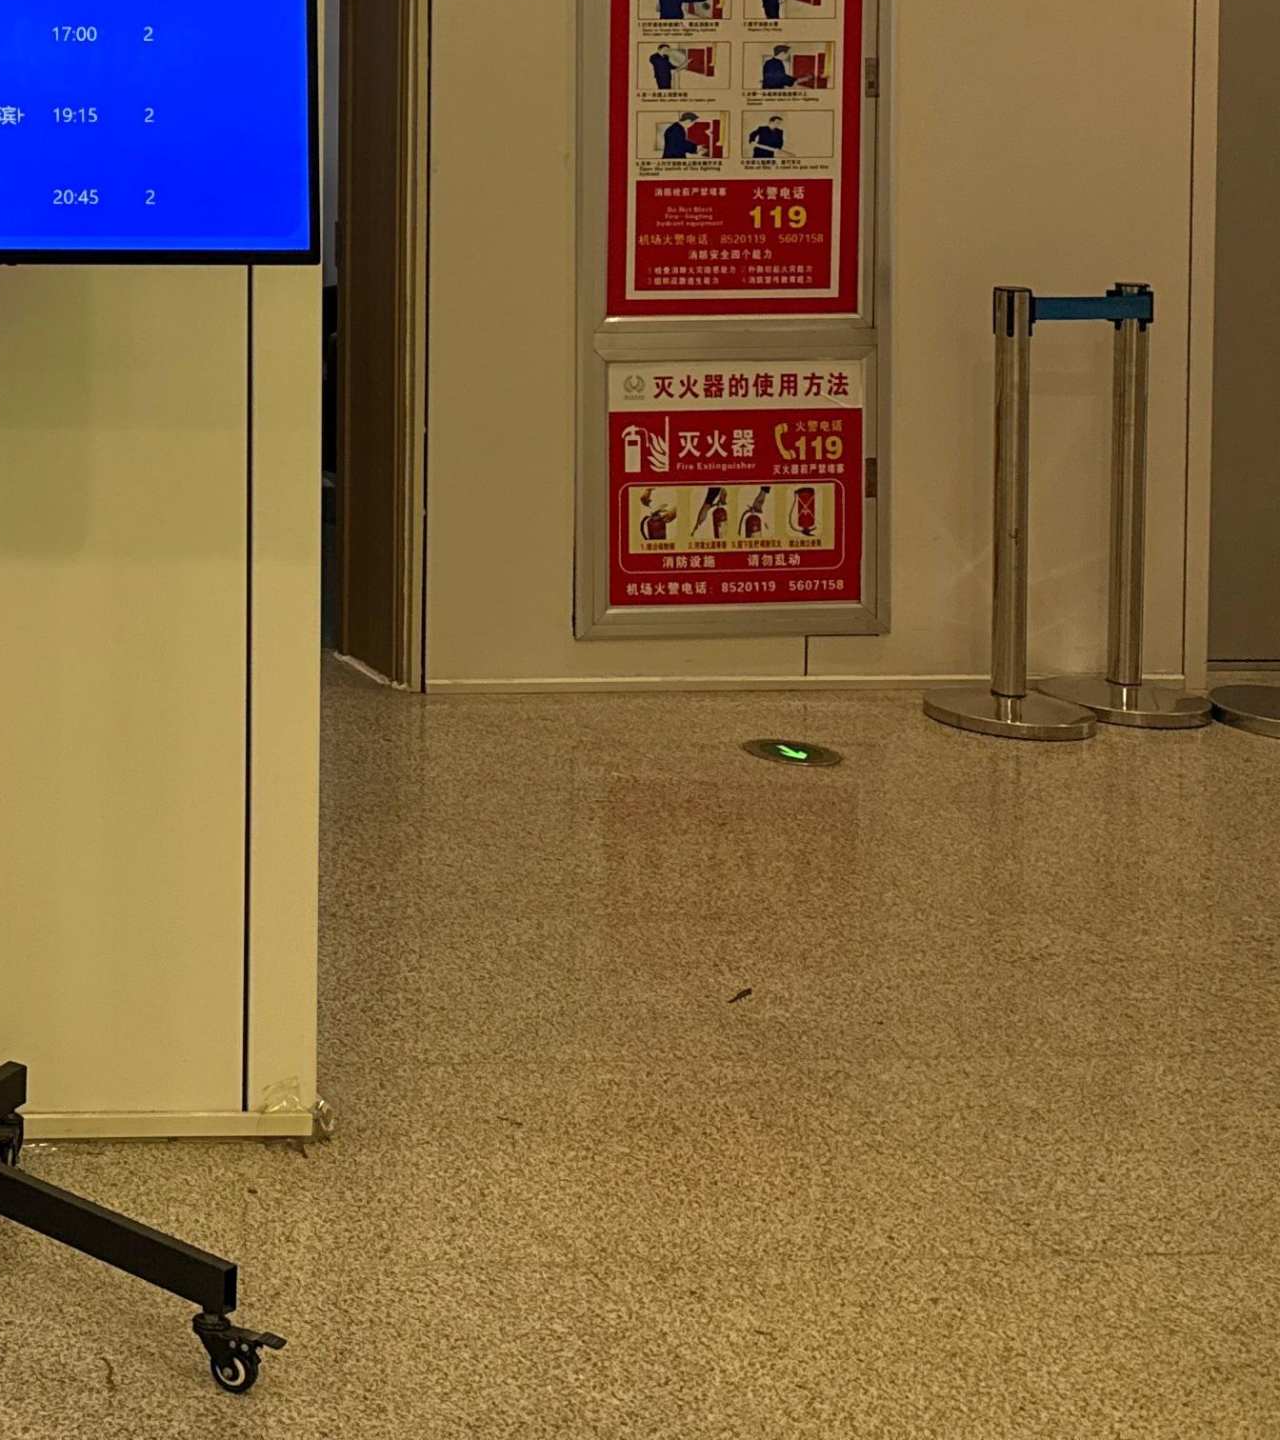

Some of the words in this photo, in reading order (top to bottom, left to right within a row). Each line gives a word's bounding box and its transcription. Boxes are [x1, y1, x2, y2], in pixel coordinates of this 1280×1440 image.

[51, 27, 97, 42] 17:00
[143, 27, 154, 42] 2
[52, 108, 98, 124] 19:15
[144, 108, 155, 124] 2
[52, 189, 99, 205] 20:45
[145, 189, 156, 205] 2
[753, 186, 806, 200] 火警电话
[749, 205, 807, 228] 119
[720, 233, 767, 244] 8520119
[778, 233, 824, 244] 5607158
[653, 372, 849, 399] 灭火器的使用方法
[795, 419, 843, 433] 火警电话
[677, 429, 755, 458] 灭火器
[794, 435, 843, 461] 119
[676, 462, 694, 471] Fire
[697, 461, 756, 471] Extinguisher
[662, 555, 716, 569] 消防设施
[747, 553, 801, 567] 请勿乱动
[721, 580, 776, 594] 8520119
[788, 578, 844, 592] 5607158
